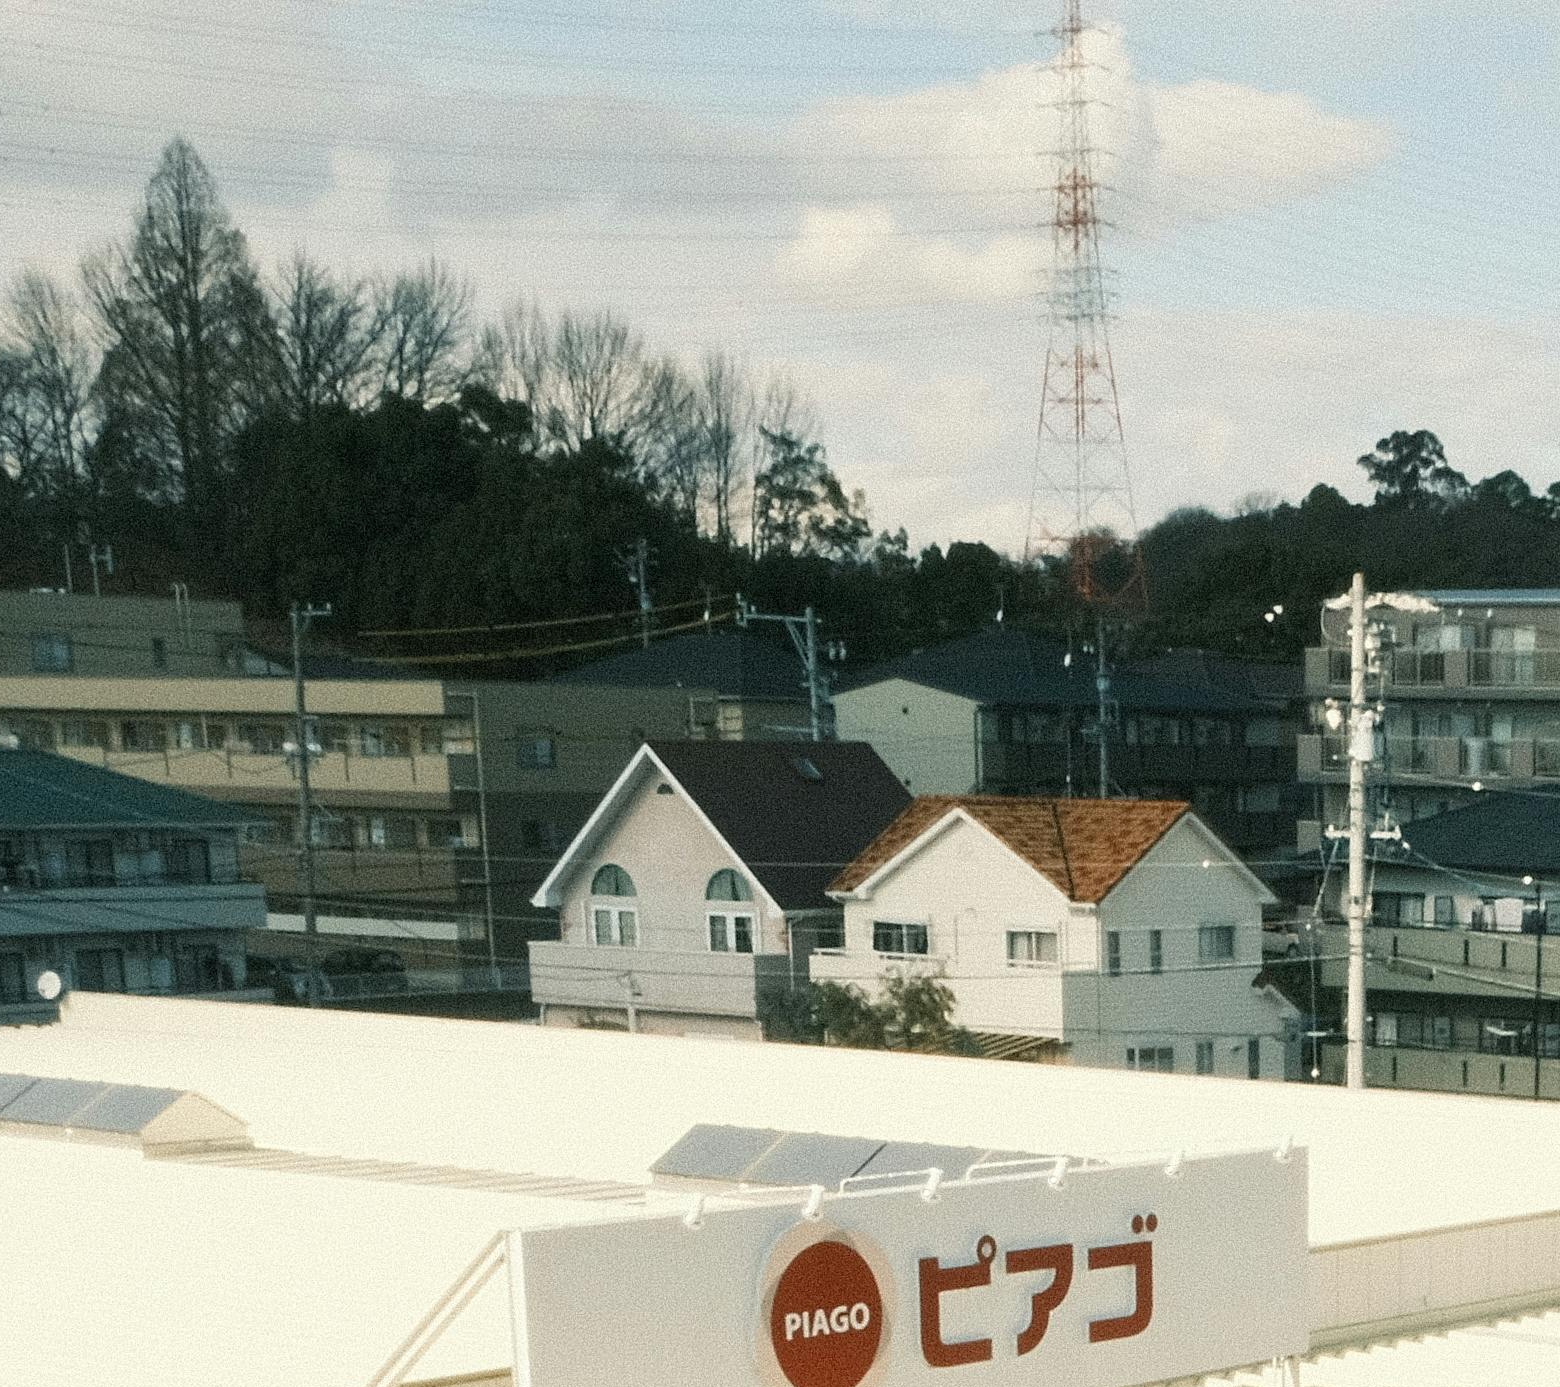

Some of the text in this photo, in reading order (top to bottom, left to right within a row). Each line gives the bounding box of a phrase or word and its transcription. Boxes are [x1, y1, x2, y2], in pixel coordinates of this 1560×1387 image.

[783, 1300, 870, 1342] PIAGO
[917, 1212, 1158, 1368] ピアゴ
